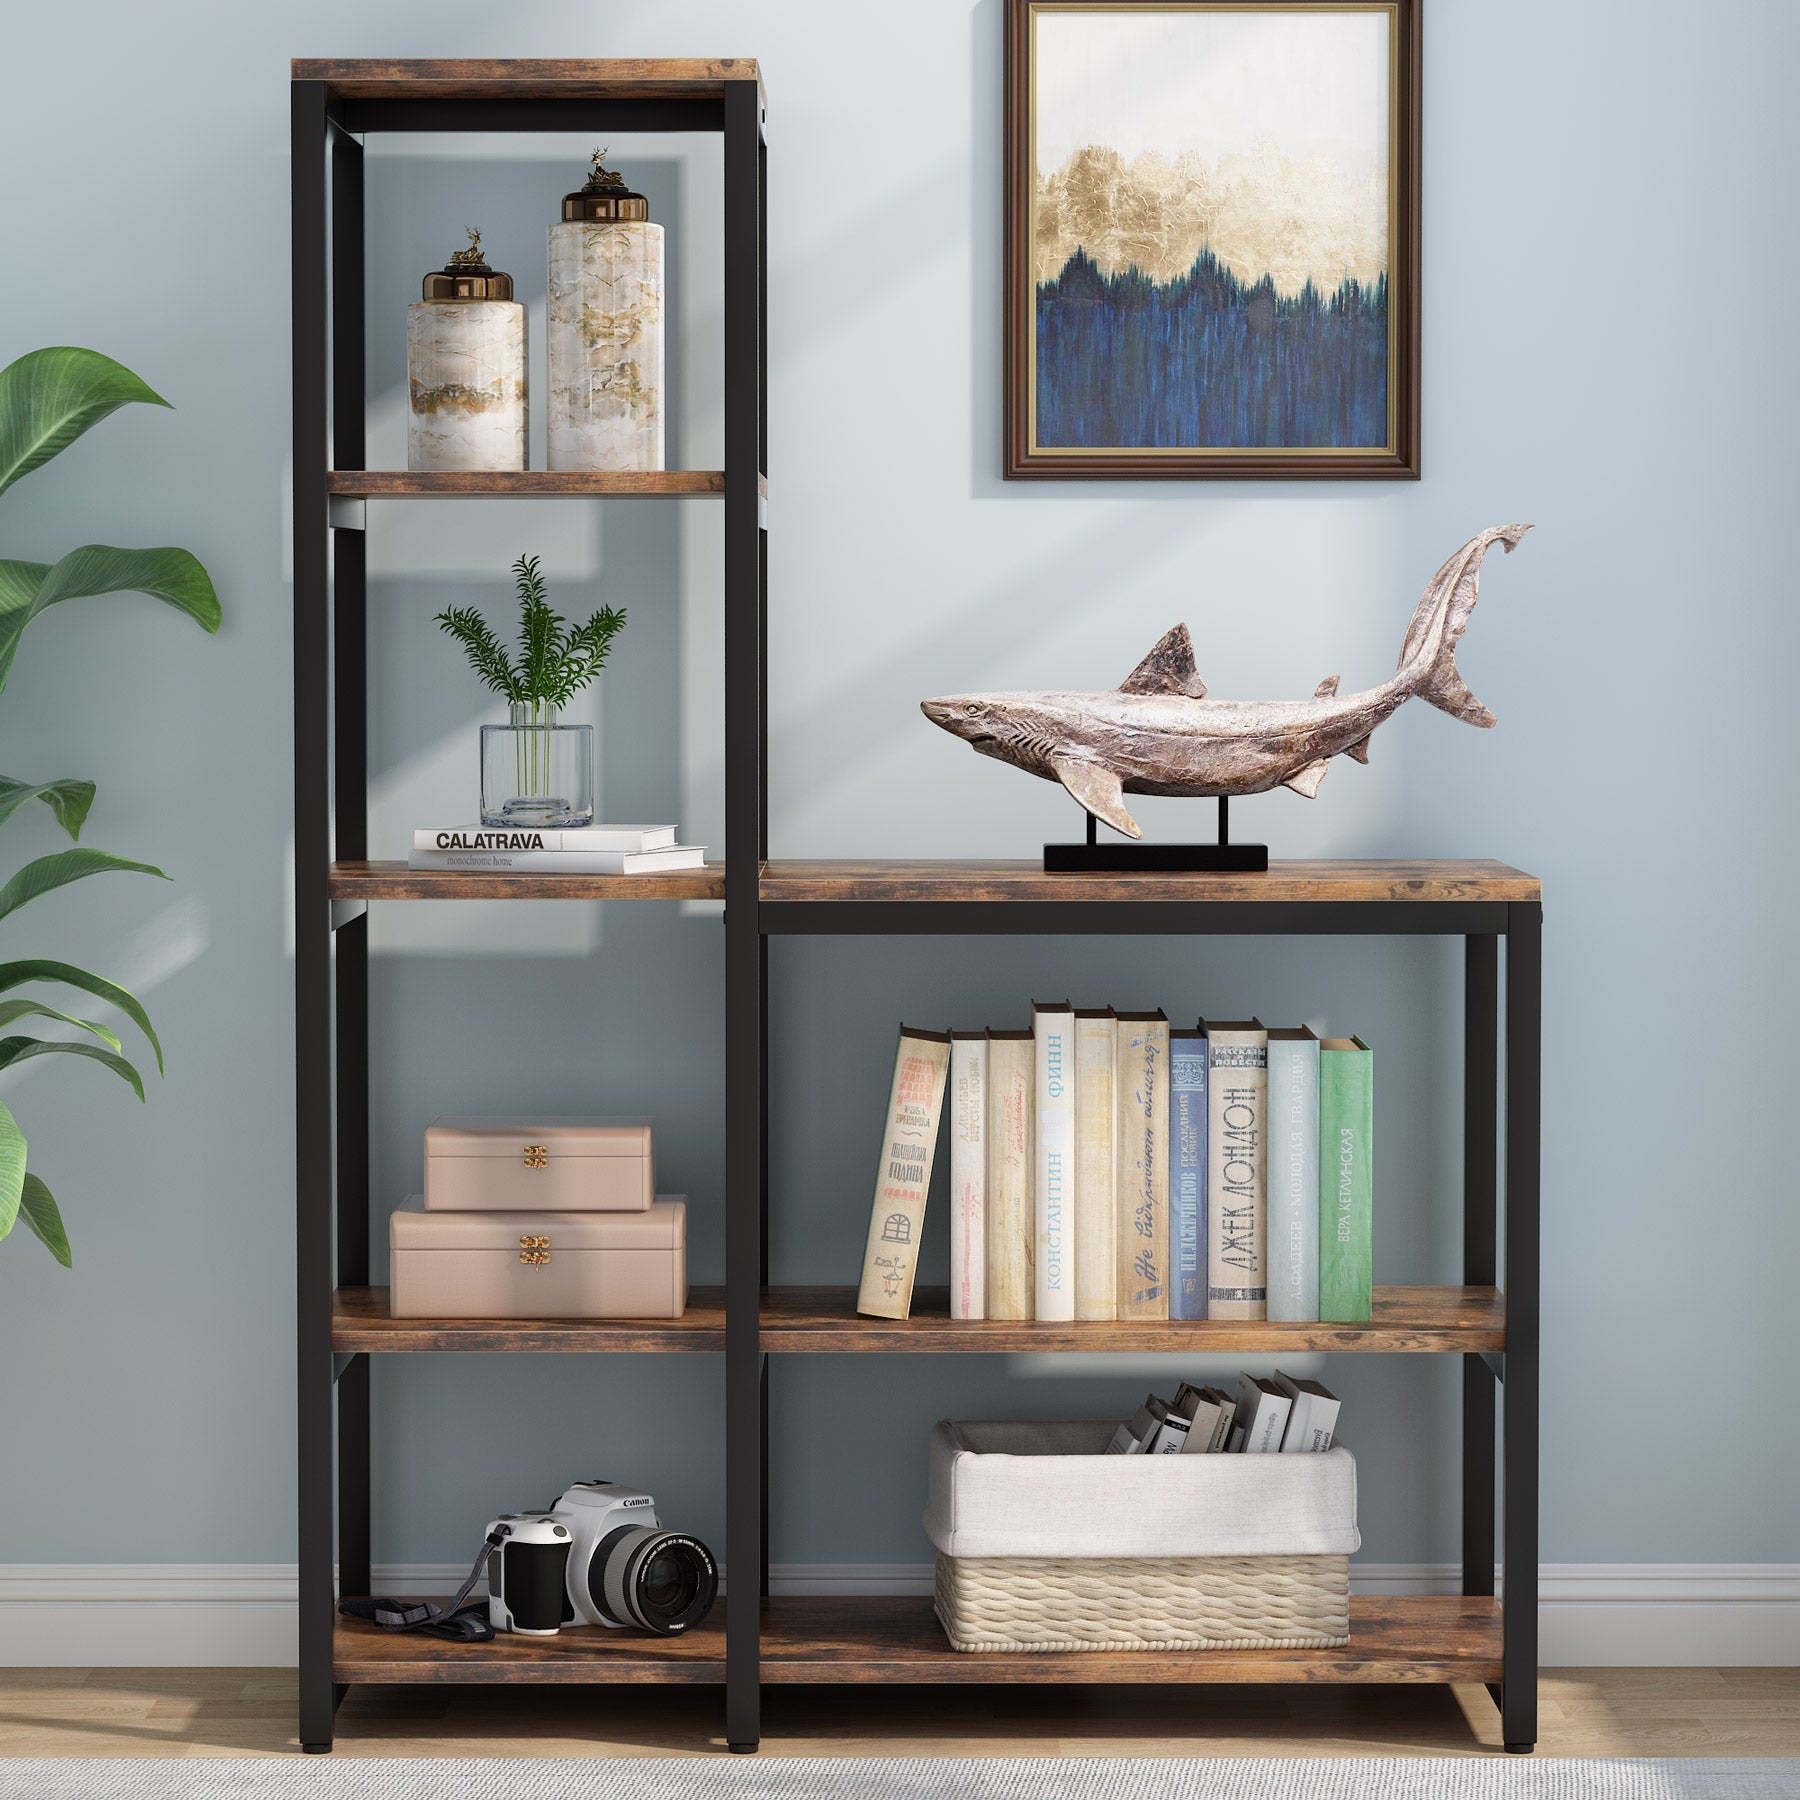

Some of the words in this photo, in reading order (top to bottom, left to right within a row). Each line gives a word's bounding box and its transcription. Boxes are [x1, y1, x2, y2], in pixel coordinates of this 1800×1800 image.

[436, 832, 544, 849] CALATRAVA
[447, 855, 491, 866] monochrome
[493, 855, 512, 866] home
[1048, 1034, 1062, 1098] ФИНН
[1290, 1053, 1305, 1124] ГВАРДИЯ
[1222, 1088, 1259, 1198] ЛОНДОН
[1338, 1128, 1354, 1211] КЕТЛИНСКАЯ
[1048, 1152, 1062, 1290] КОНСТАНТИН
[1220, 1205, 1258, 1272] ДЖЕК
[1338, 1215, 1351, 1242] ВЕРА
[623, 1498, 650, 1508] Canon
